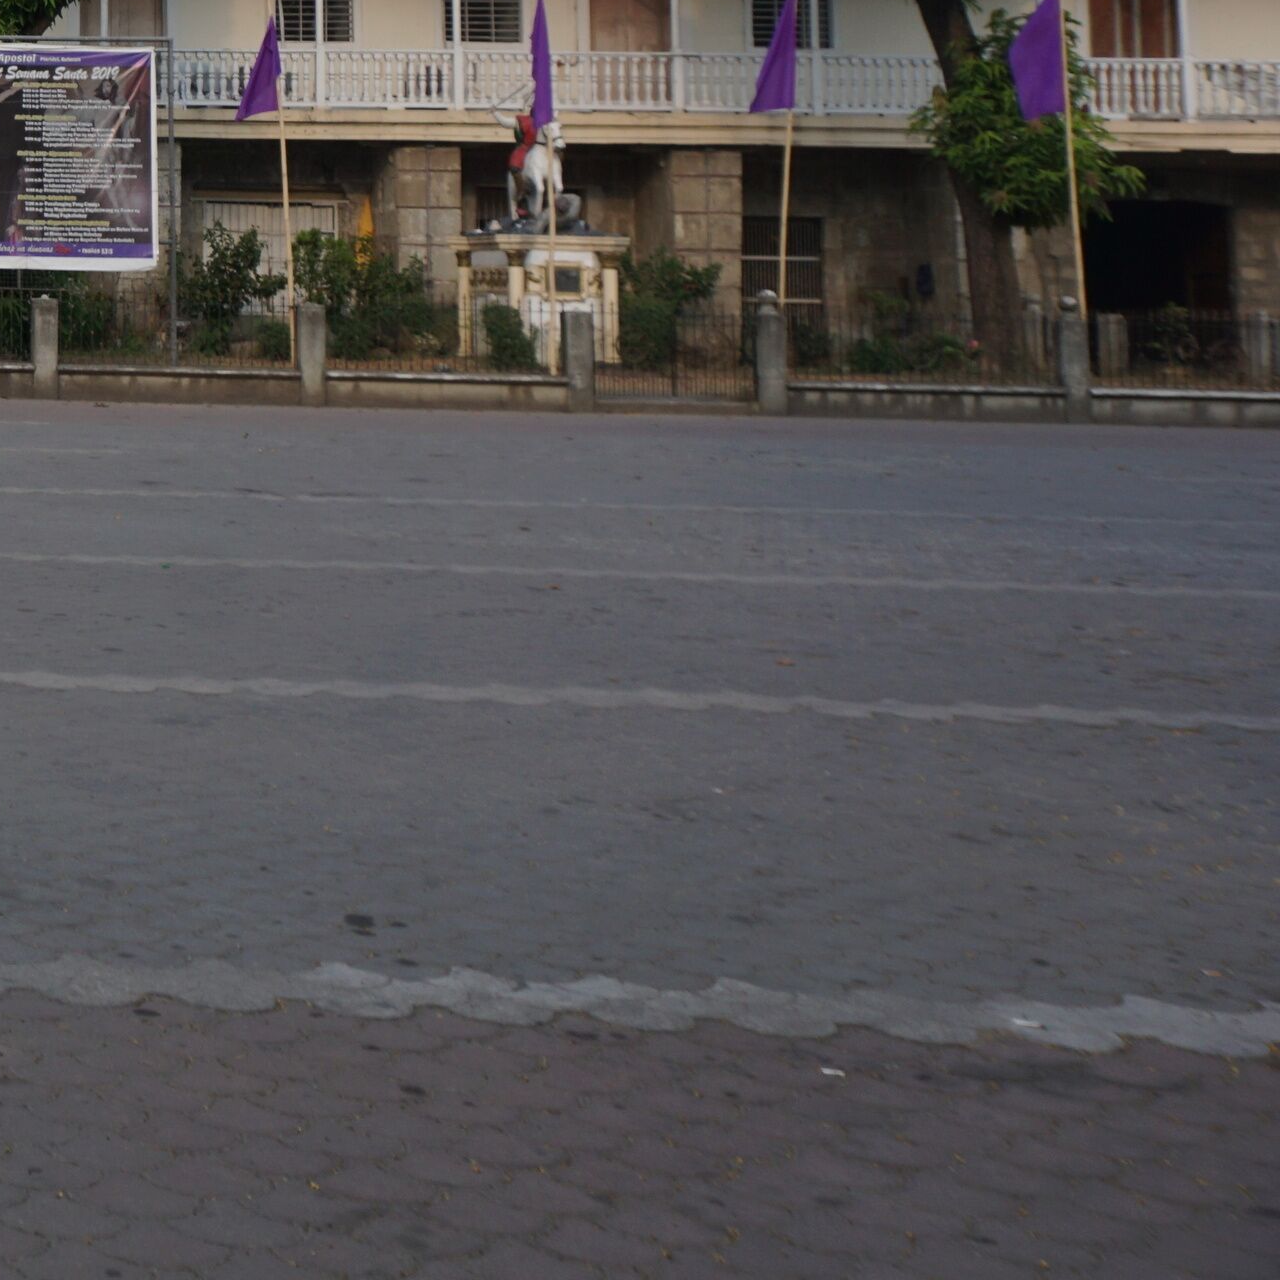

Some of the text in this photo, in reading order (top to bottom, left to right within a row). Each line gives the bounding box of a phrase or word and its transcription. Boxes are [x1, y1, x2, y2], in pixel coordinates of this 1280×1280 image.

[5, 66, 50, 80] Semana
[53, 67, 89, 80] Santa
[91, 66, 120, 80] 2019
